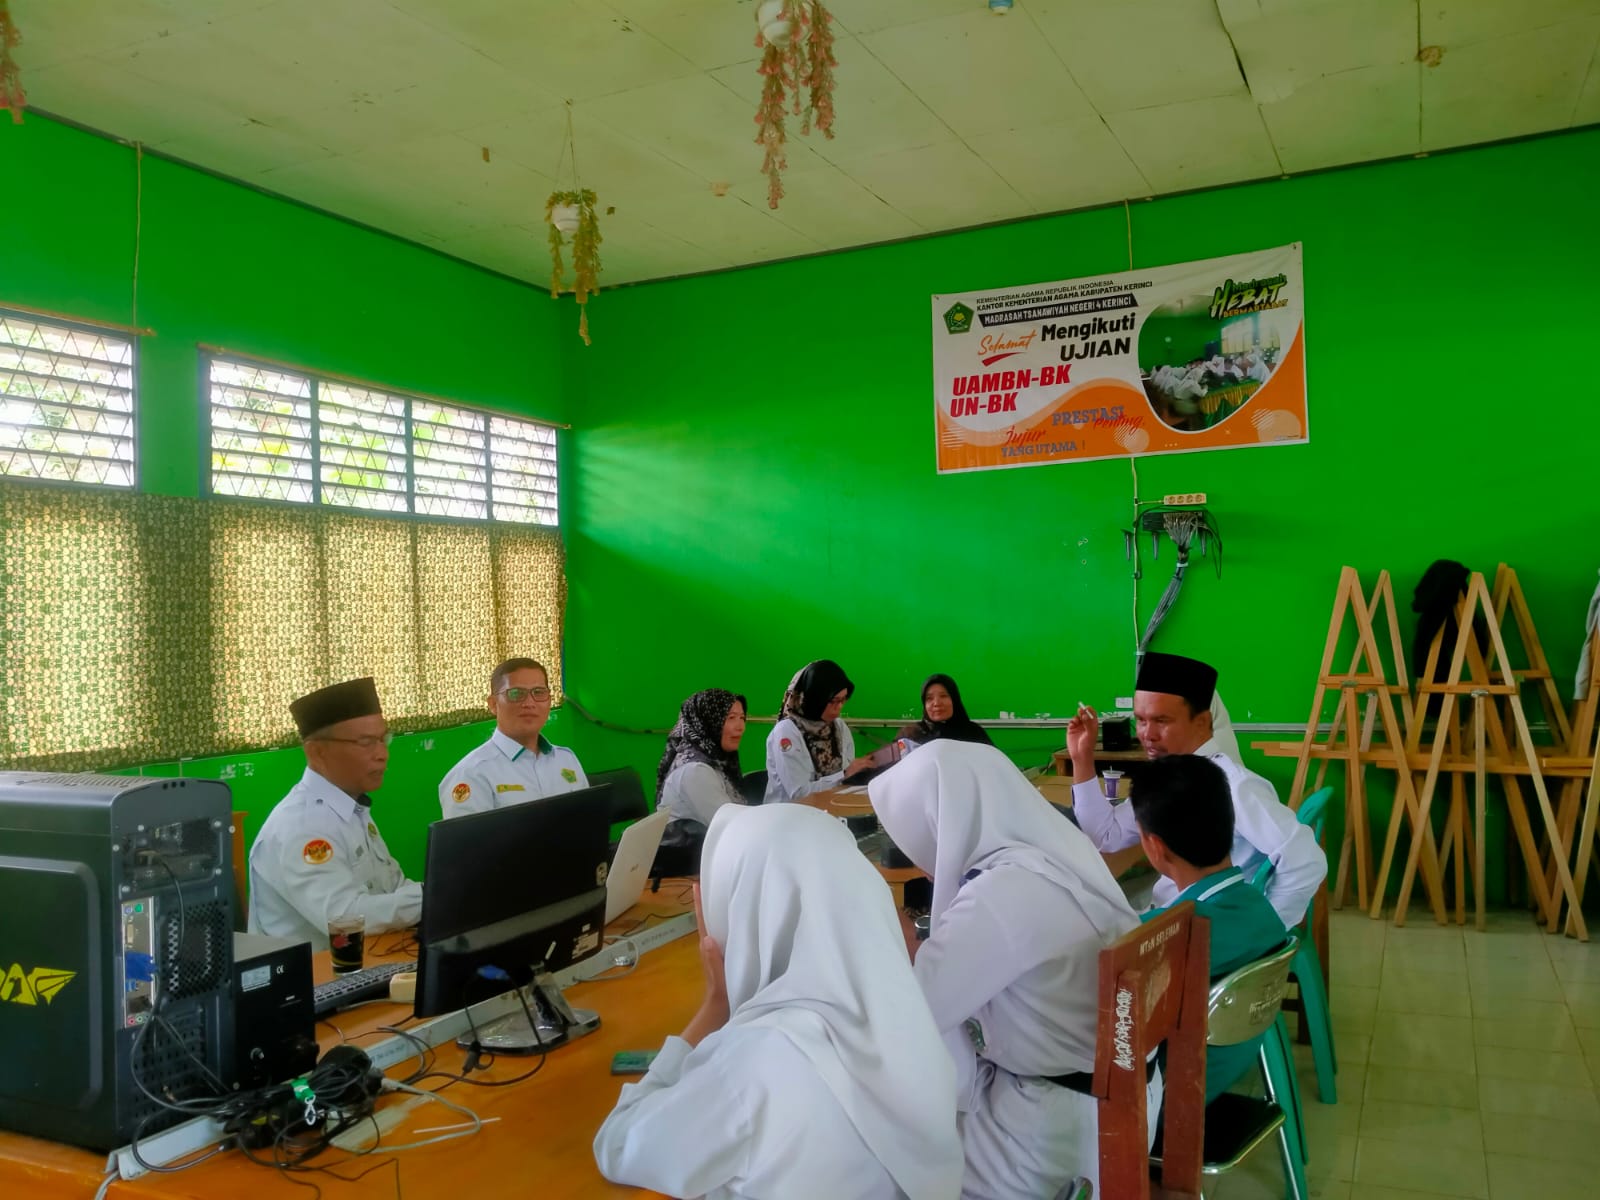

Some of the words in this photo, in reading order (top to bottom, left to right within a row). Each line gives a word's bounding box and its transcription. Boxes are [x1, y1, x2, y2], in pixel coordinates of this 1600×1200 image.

[976, 293, 1020, 304] KEMENTERIAN
[1021, 290, 1044, 299] AGAMA
[1045, 285, 1077, 295] REPUBLIK
[1078, 280, 1114, 290] INDONESIA
[976, 302, 1004, 311] KANTOR
[1004, 295, 1053, 307] KEMENTERIAN
[1054, 291, 1079, 301] AGAMA
[1080, 285, 1123, 297] KABUPATEN
[1124, 281, 1153, 291] KERINCI
[1209, 279, 1288, 320] HEBAT
[984, 311, 1023, 325] MADRASAH
[1023, 305, 1069, 320] TSANAWIYAH
[1069, 301, 1095, 313] NEGERI
[1095, 301, 1101, 310] 4
[1102, 296, 1131, 308] KERINCI
[977, 329, 1038, 356] Selamat
[1041, 312, 1136, 342] Mengikuti
[1060, 337, 1131, 361] UJIAN
[952, 364, 1072, 396] UAMBN-BK
[950, 392, 1018, 417] UN-BK
[1051, 405, 1125, 427] PRESTASI
